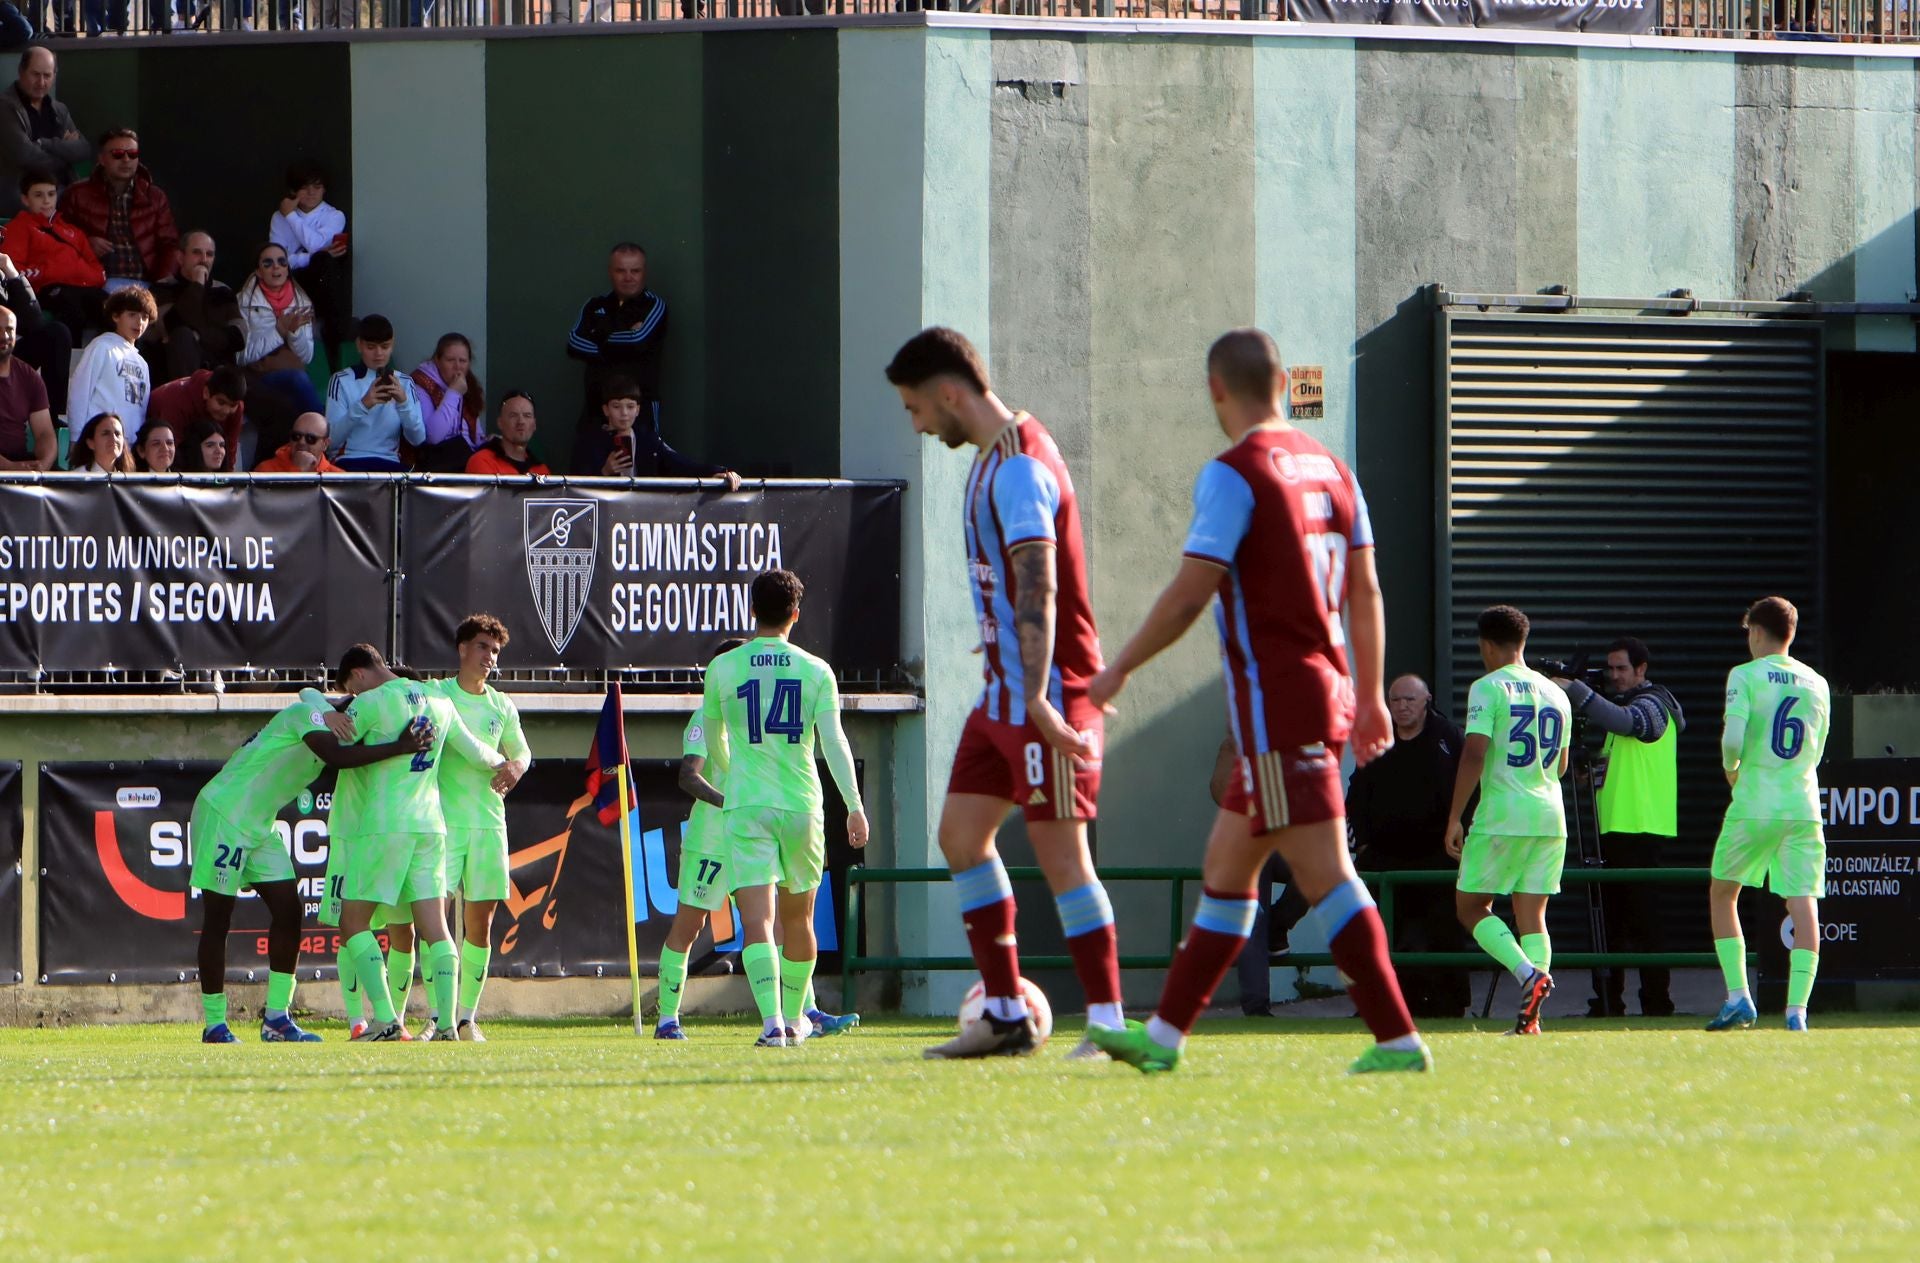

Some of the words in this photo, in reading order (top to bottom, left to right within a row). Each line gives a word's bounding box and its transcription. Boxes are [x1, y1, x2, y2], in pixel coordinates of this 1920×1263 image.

[107, 535, 238, 569] MUNICIPAL
[245, 536, 274, 569] DE
[611, 511, 782, 571] GIMNÁSTICA
[149, 582, 276, 622] SEGOVIA
[611, 582, 756, 631] SEGOVIAN
[750, 652, 791, 667] CORTÉS
[1767, 671, 1789, 684] PAU
[736, 678, 804, 744] 14
[1771, 695, 1805, 760] 6
[1507, 704, 1563, 769] 39
[1024, 742, 1044, 786] 8
[214, 844, 243, 871] 24
[697, 858, 722, 885] 17
[1845, 853, 1915, 876] GONZÁLEZ,
[1842, 876, 1900, 896] CASTAÑO
[304, 902, 322, 917] pa
